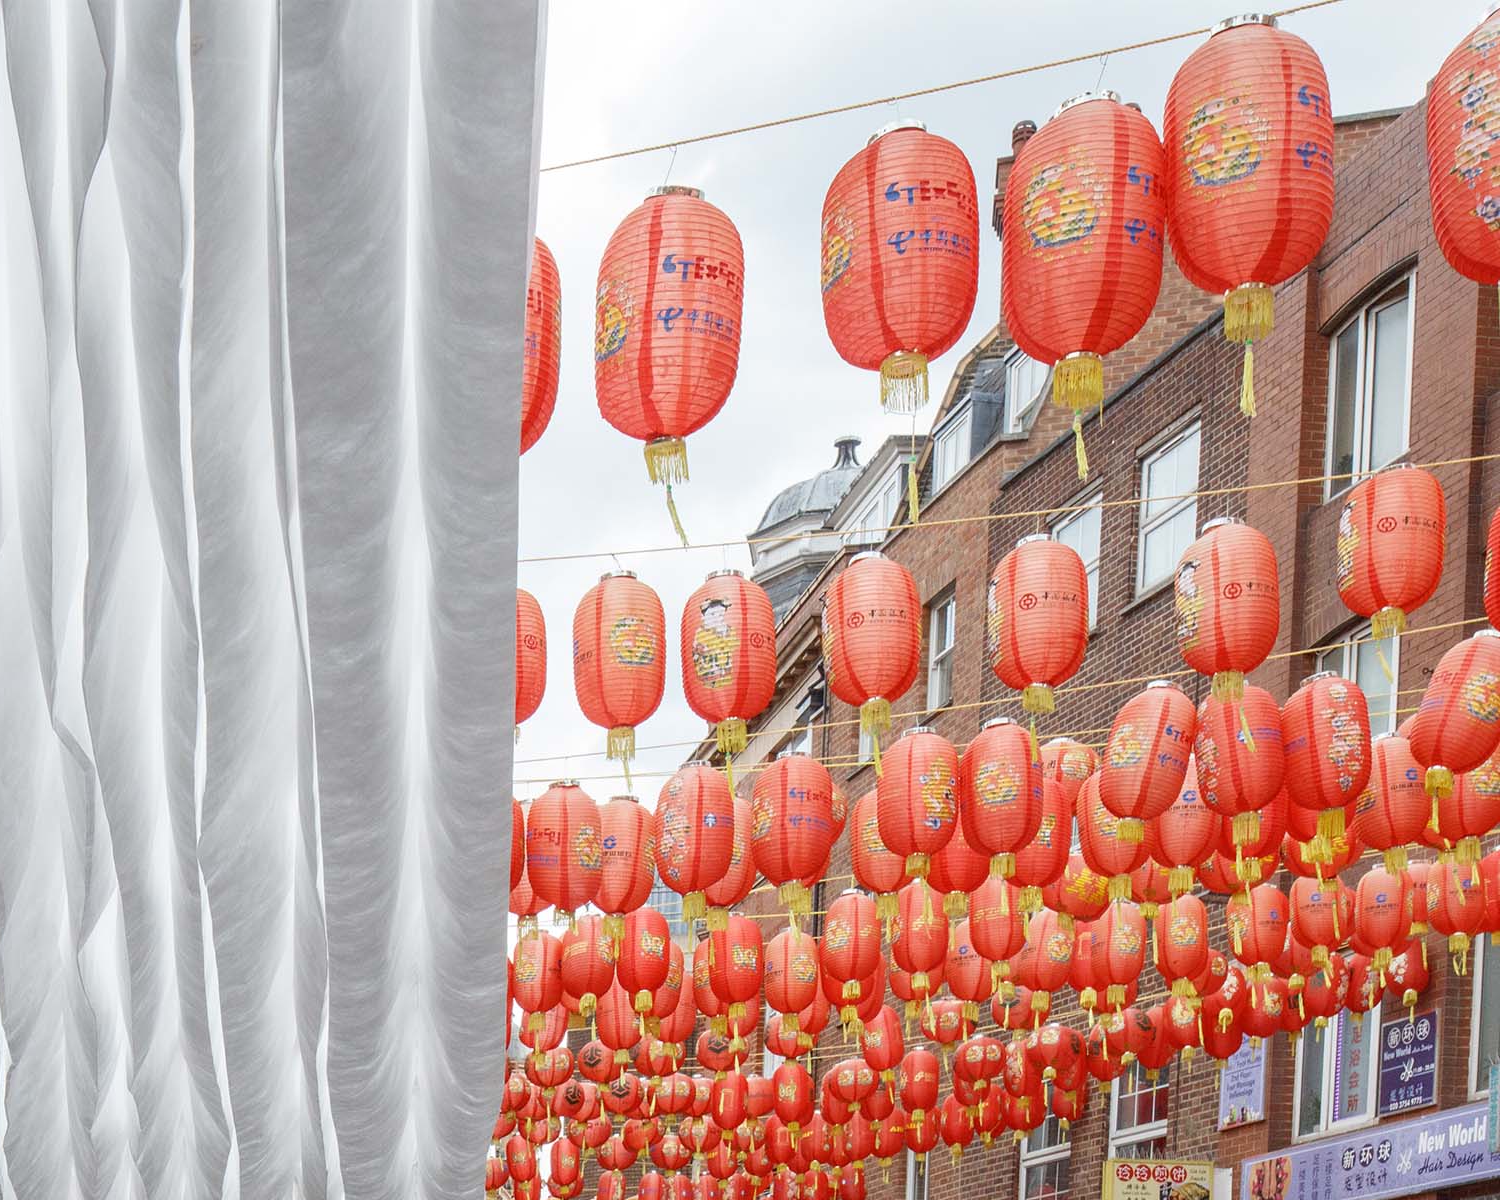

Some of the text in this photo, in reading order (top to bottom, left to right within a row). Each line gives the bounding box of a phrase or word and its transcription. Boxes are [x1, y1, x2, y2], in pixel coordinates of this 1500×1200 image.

[1395, 1044, 1411, 1059] World
[1418, 1115, 1487, 1155] New World
[1343, 1141, 1391, 1170] 新环球
[1417, 1150, 1484, 1176] Hair Design
